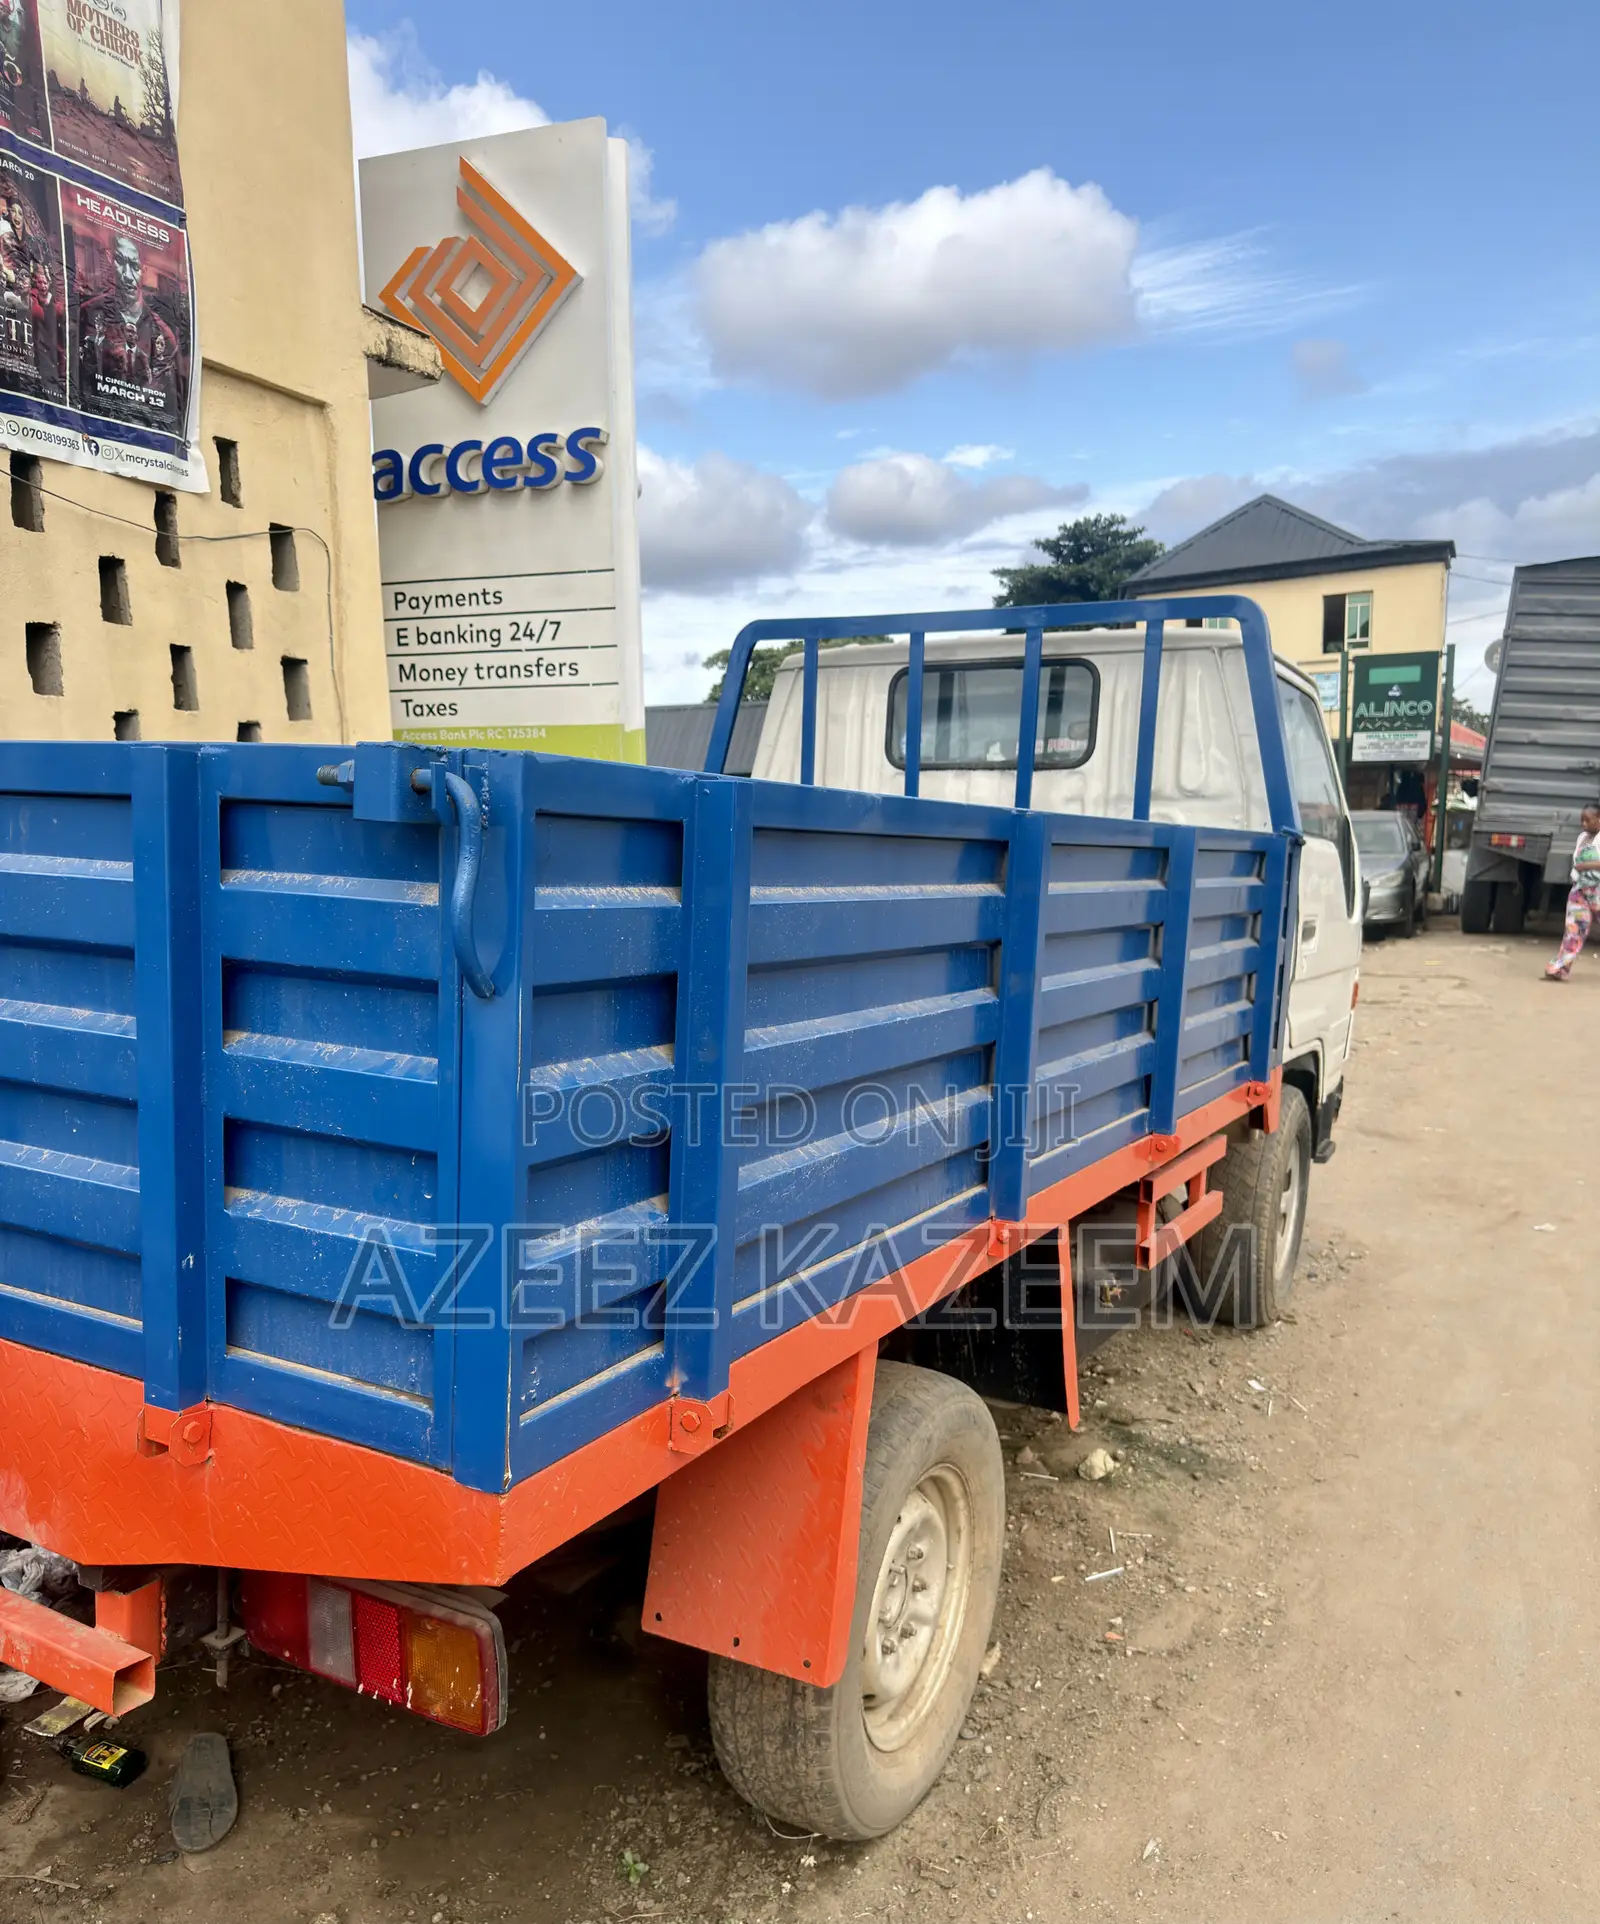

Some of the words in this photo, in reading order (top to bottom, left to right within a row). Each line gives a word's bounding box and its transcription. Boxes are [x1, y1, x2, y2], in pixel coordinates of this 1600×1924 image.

[67, 0, 140, 48] MOTHERS
[67, 12, 85, 35] OF
[90, 25, 144, 67] CHIBOK
[24, 170, 35, 181] 20
[76, 193, 170, 243] HEADLESS
[95, 373, 104, 381] IN
[105, 376, 141, 392] CINEMAS
[142, 387, 166, 398] FROM
[96, 382, 146, 403] MARCH
[148, 396, 165, 408] 13
[21, 425, 81, 451] 07038199363
[371, 426, 606, 501] access
[393, 587, 503, 615] Payments
[396, 627, 409, 647] E
[416, 622, 502, 650] banking
[509, 618, 562, 644] 24/7
[398, 662, 468, 686] Money
[474, 657, 580, 681] transfers
[401, 698, 458, 718] Taxes
[1354, 699, 1434, 719] ALINCO
[401, 730, 437, 741] Access
[439, 729, 467, 740] Bank
[469, 729, 486, 740] Plc
[508, 727, 547, 738] 125384
